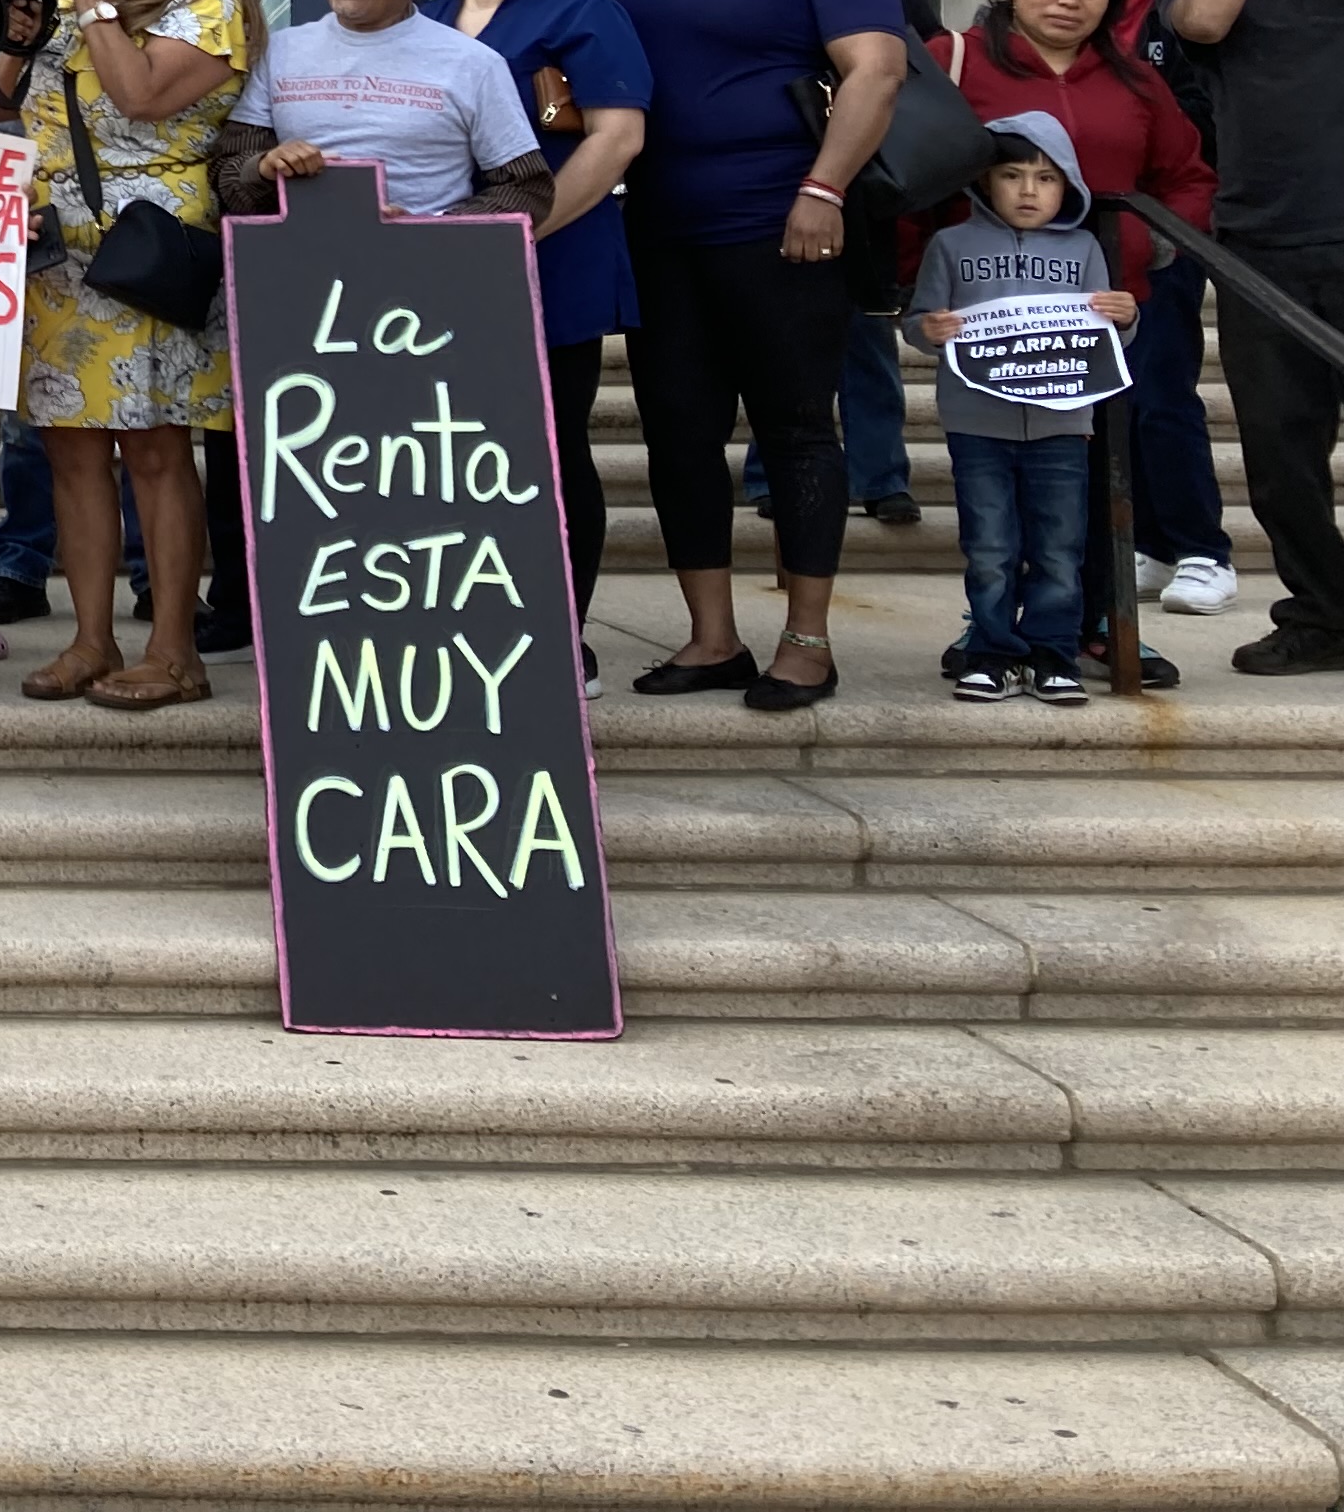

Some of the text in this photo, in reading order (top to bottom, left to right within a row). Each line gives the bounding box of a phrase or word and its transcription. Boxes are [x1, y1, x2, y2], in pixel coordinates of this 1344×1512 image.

[273, 93, 444, 111] MASSACHUSETTS ACTION FUND
[276, 76, 443, 100] NEIGHBOR TO NEIGHBOR
[961, 254, 1081, 285] OSHKOSH
[313, 279, 453, 356] La
[1028, 304, 1090, 314] RECOVER
[970, 335, 1099, 359] Use ARPA for
[989, 358, 1088, 378] affordable
[261, 374, 539, 522] Renta
[299, 533, 524, 616] ESTA
[307, 633, 532, 734] MUY
[295, 764, 585, 899] CARA
